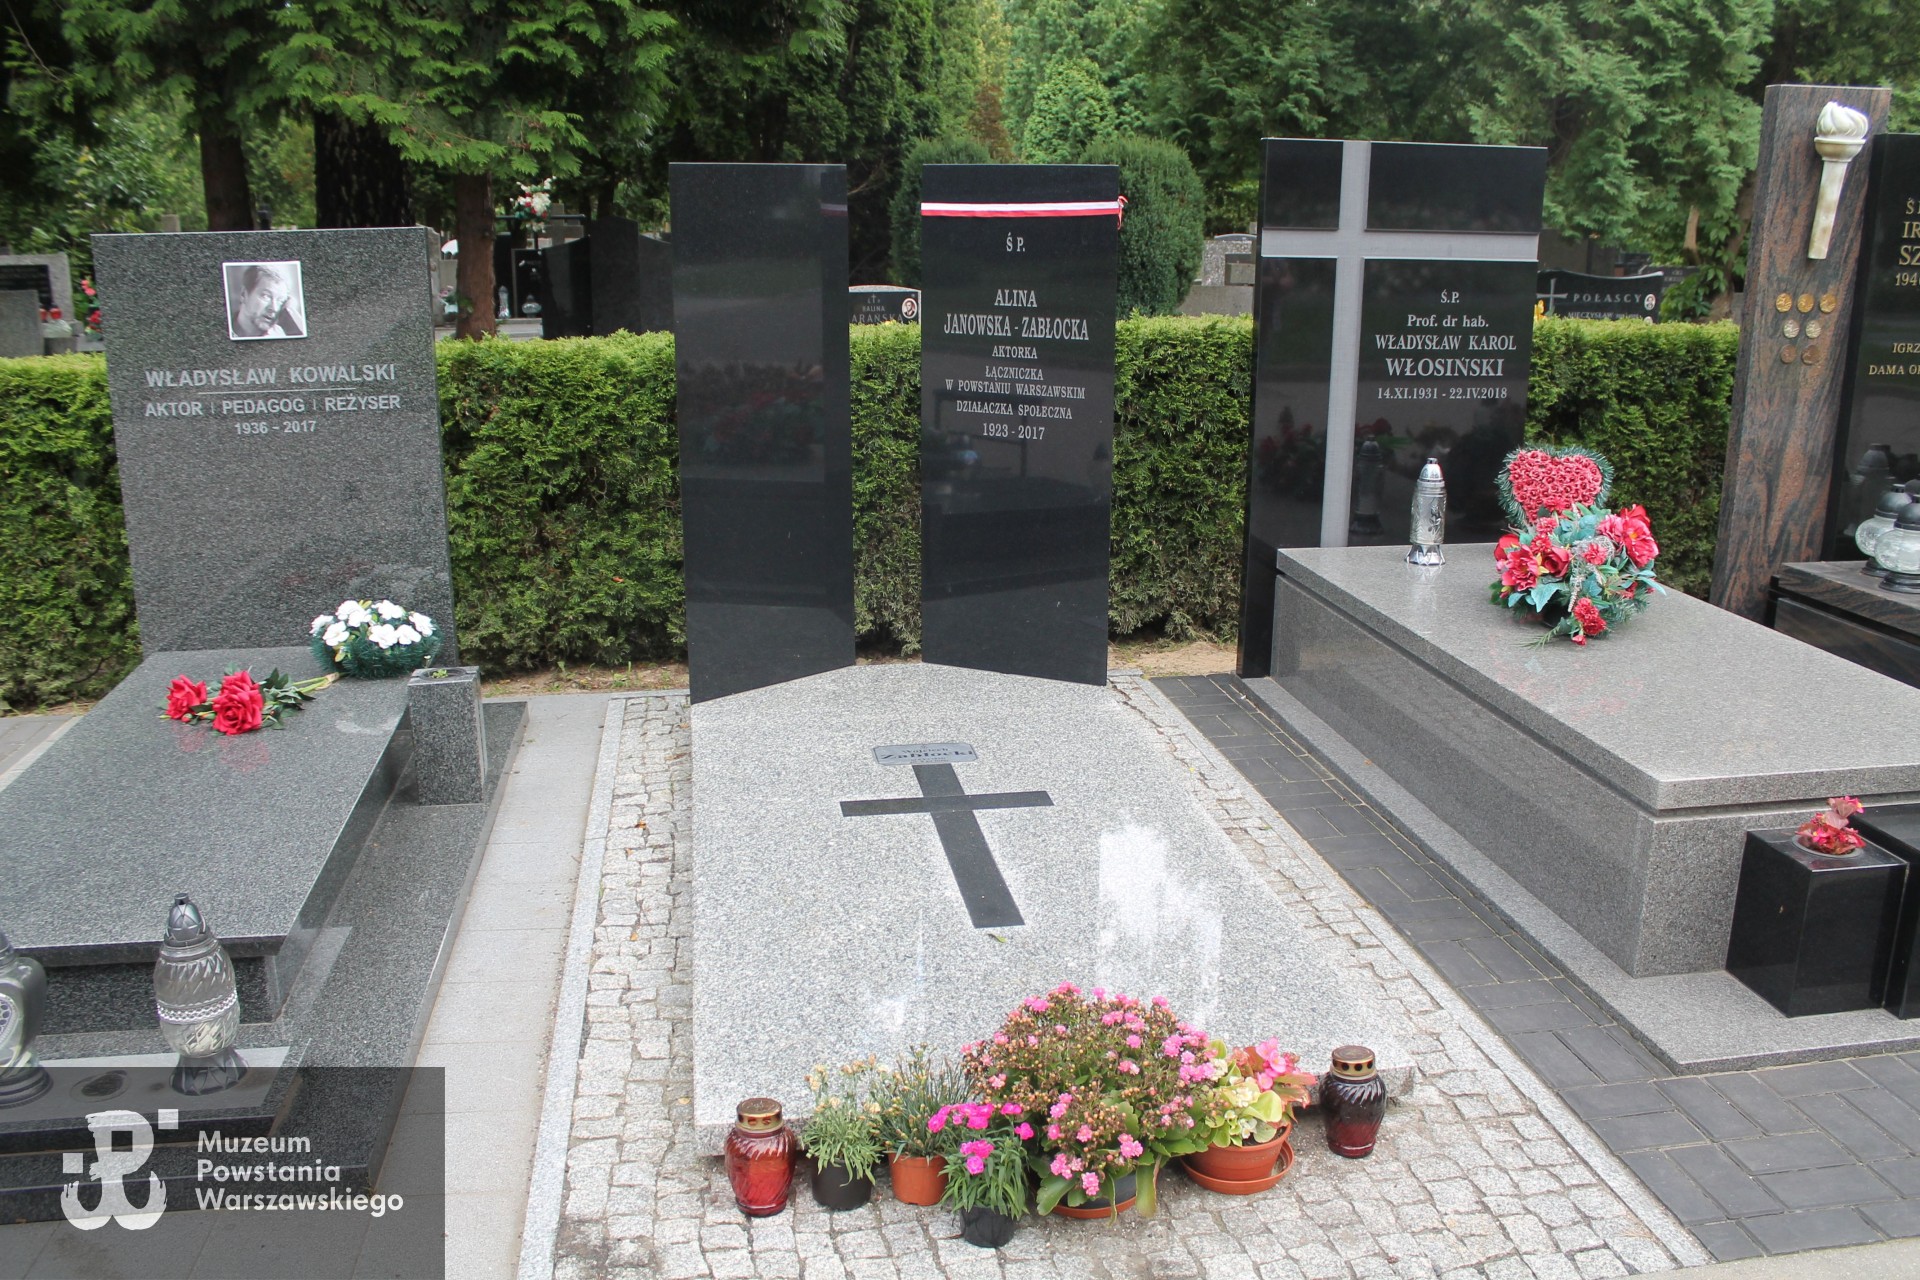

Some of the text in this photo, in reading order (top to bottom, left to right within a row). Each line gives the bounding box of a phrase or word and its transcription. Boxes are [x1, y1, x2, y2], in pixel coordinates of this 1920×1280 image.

[1895, 272, 1920, 286] 194
[994, 289, 1038, 308] ALINA
[1573, 293, 1642, 303] POŁASCY
[944, 314, 1012, 336] JANOWSKA
[1021, 316, 1089, 341] ZABŁOCKA
[1407, 314, 1489, 328] Prof. dr hab.
[1375, 334, 1517, 350] WŁADYSŁAW KAROL
[992, 345, 1038, 359] AKTORKA
[985, 365, 1044, 381] ŁĄCZNICZKA
[1385, 356, 1505, 377] WŁOSIŃSKI
[1868, 365, 1905, 375] DAMA
[145, 363, 395, 388] WŁADYSŁAW KOWALSKI
[945, 379, 1085, 399] W POWSTANIU WARSZAWSKIM
[1377, 387, 1439, 400] 14.XI.1931
[1449, 387, 1508, 400] 22.IV.2018
[145, 402, 203, 417] AKTOR
[222, 398, 305, 415] PEDAGOG
[325, 393, 401, 412] REŻYSER
[956, 400, 1073, 420] DZIAŁACZKA SPOŁECZNA
[234, 421, 268, 435] 1936
[283, 420, 317, 434] 2017
[983, 423, 1009, 438] 1923
[1018, 425, 1045, 440] 2017
